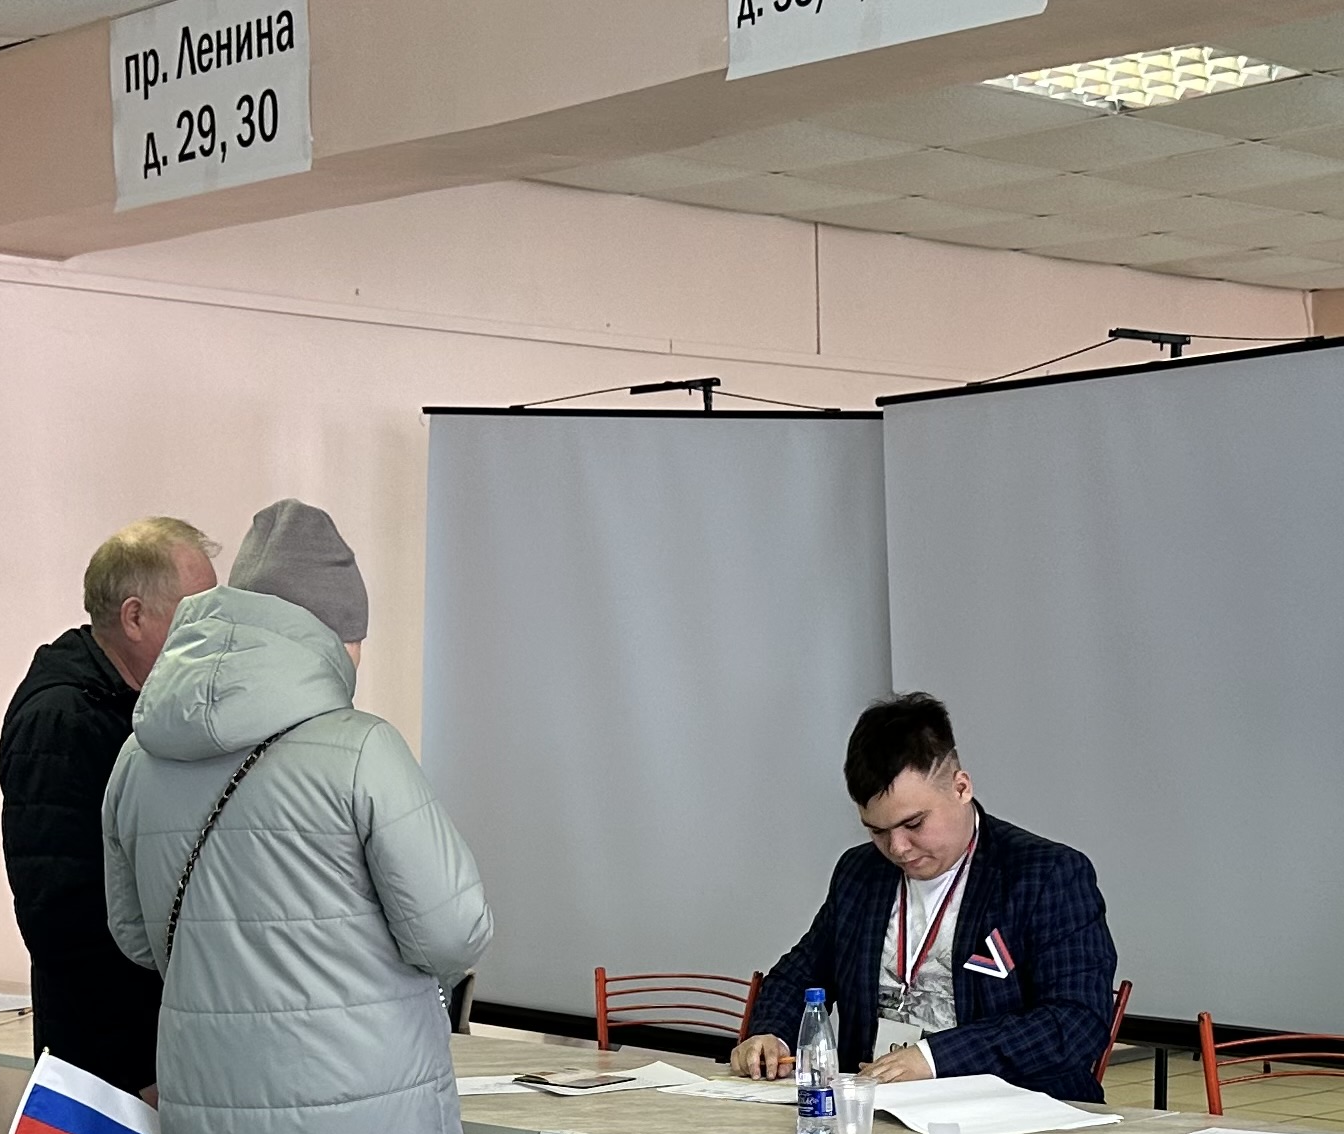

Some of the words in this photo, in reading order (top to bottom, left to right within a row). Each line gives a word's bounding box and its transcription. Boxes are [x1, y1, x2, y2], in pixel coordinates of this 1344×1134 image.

[125, 49, 168, 100] пр.
[176, 10, 294, 79] Ленина
[144, 132, 168, 179] д.
[177, 104, 226, 163] 29,
[237, 89, 278, 147] 30
